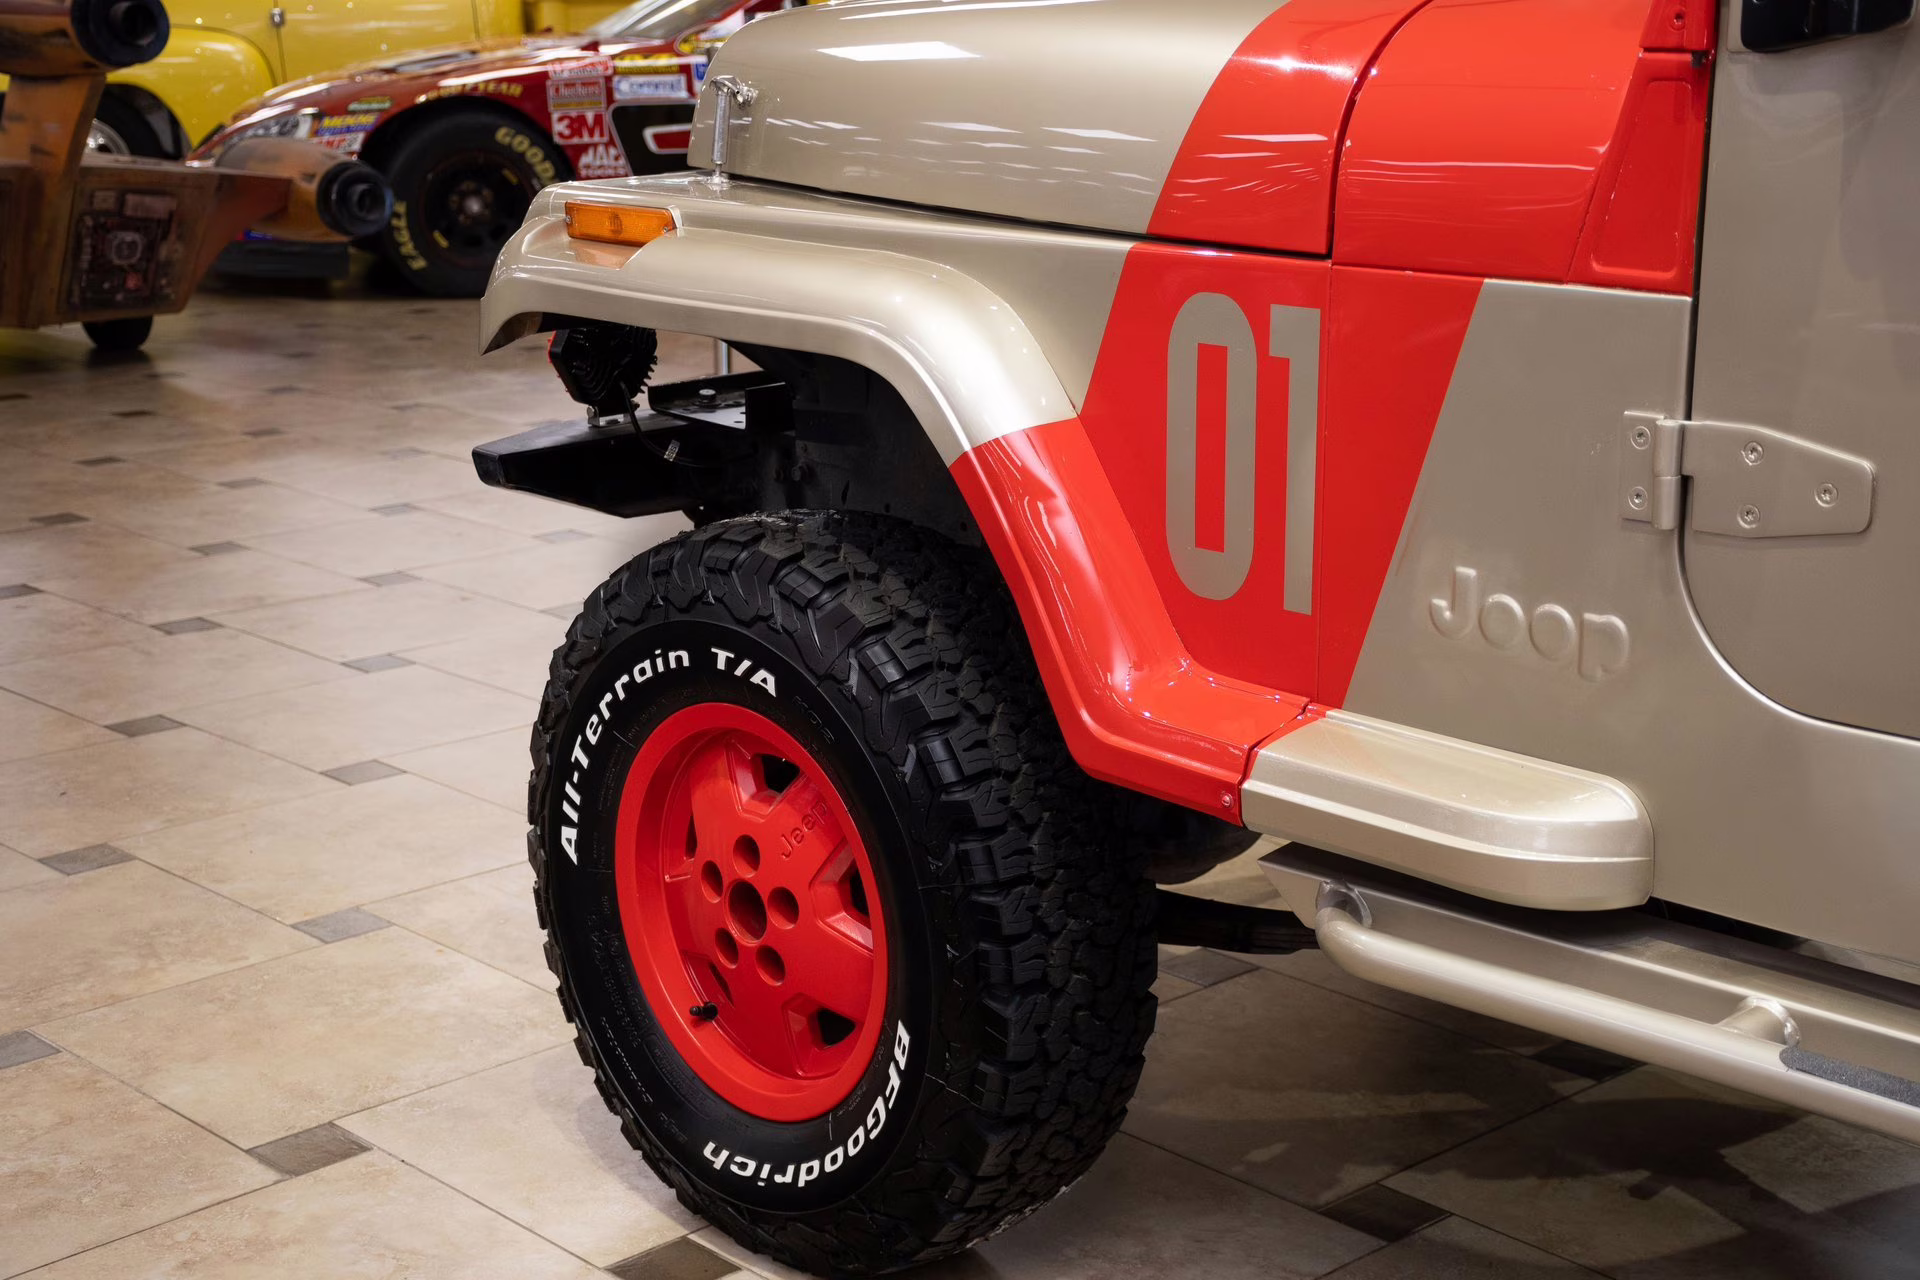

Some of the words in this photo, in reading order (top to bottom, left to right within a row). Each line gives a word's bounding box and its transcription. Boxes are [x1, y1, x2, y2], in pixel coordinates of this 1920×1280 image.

[494, 126, 557, 185] GOOD
[557, 114, 605, 140] 3M
[1165, 291, 1321, 616] 01
[560, 648, 691, 866] All-Terrain
[710, 647, 778, 698] T/A
[780, 800, 828, 861] Jeep
[703, 1019, 910, 1188] BFGoodrich
